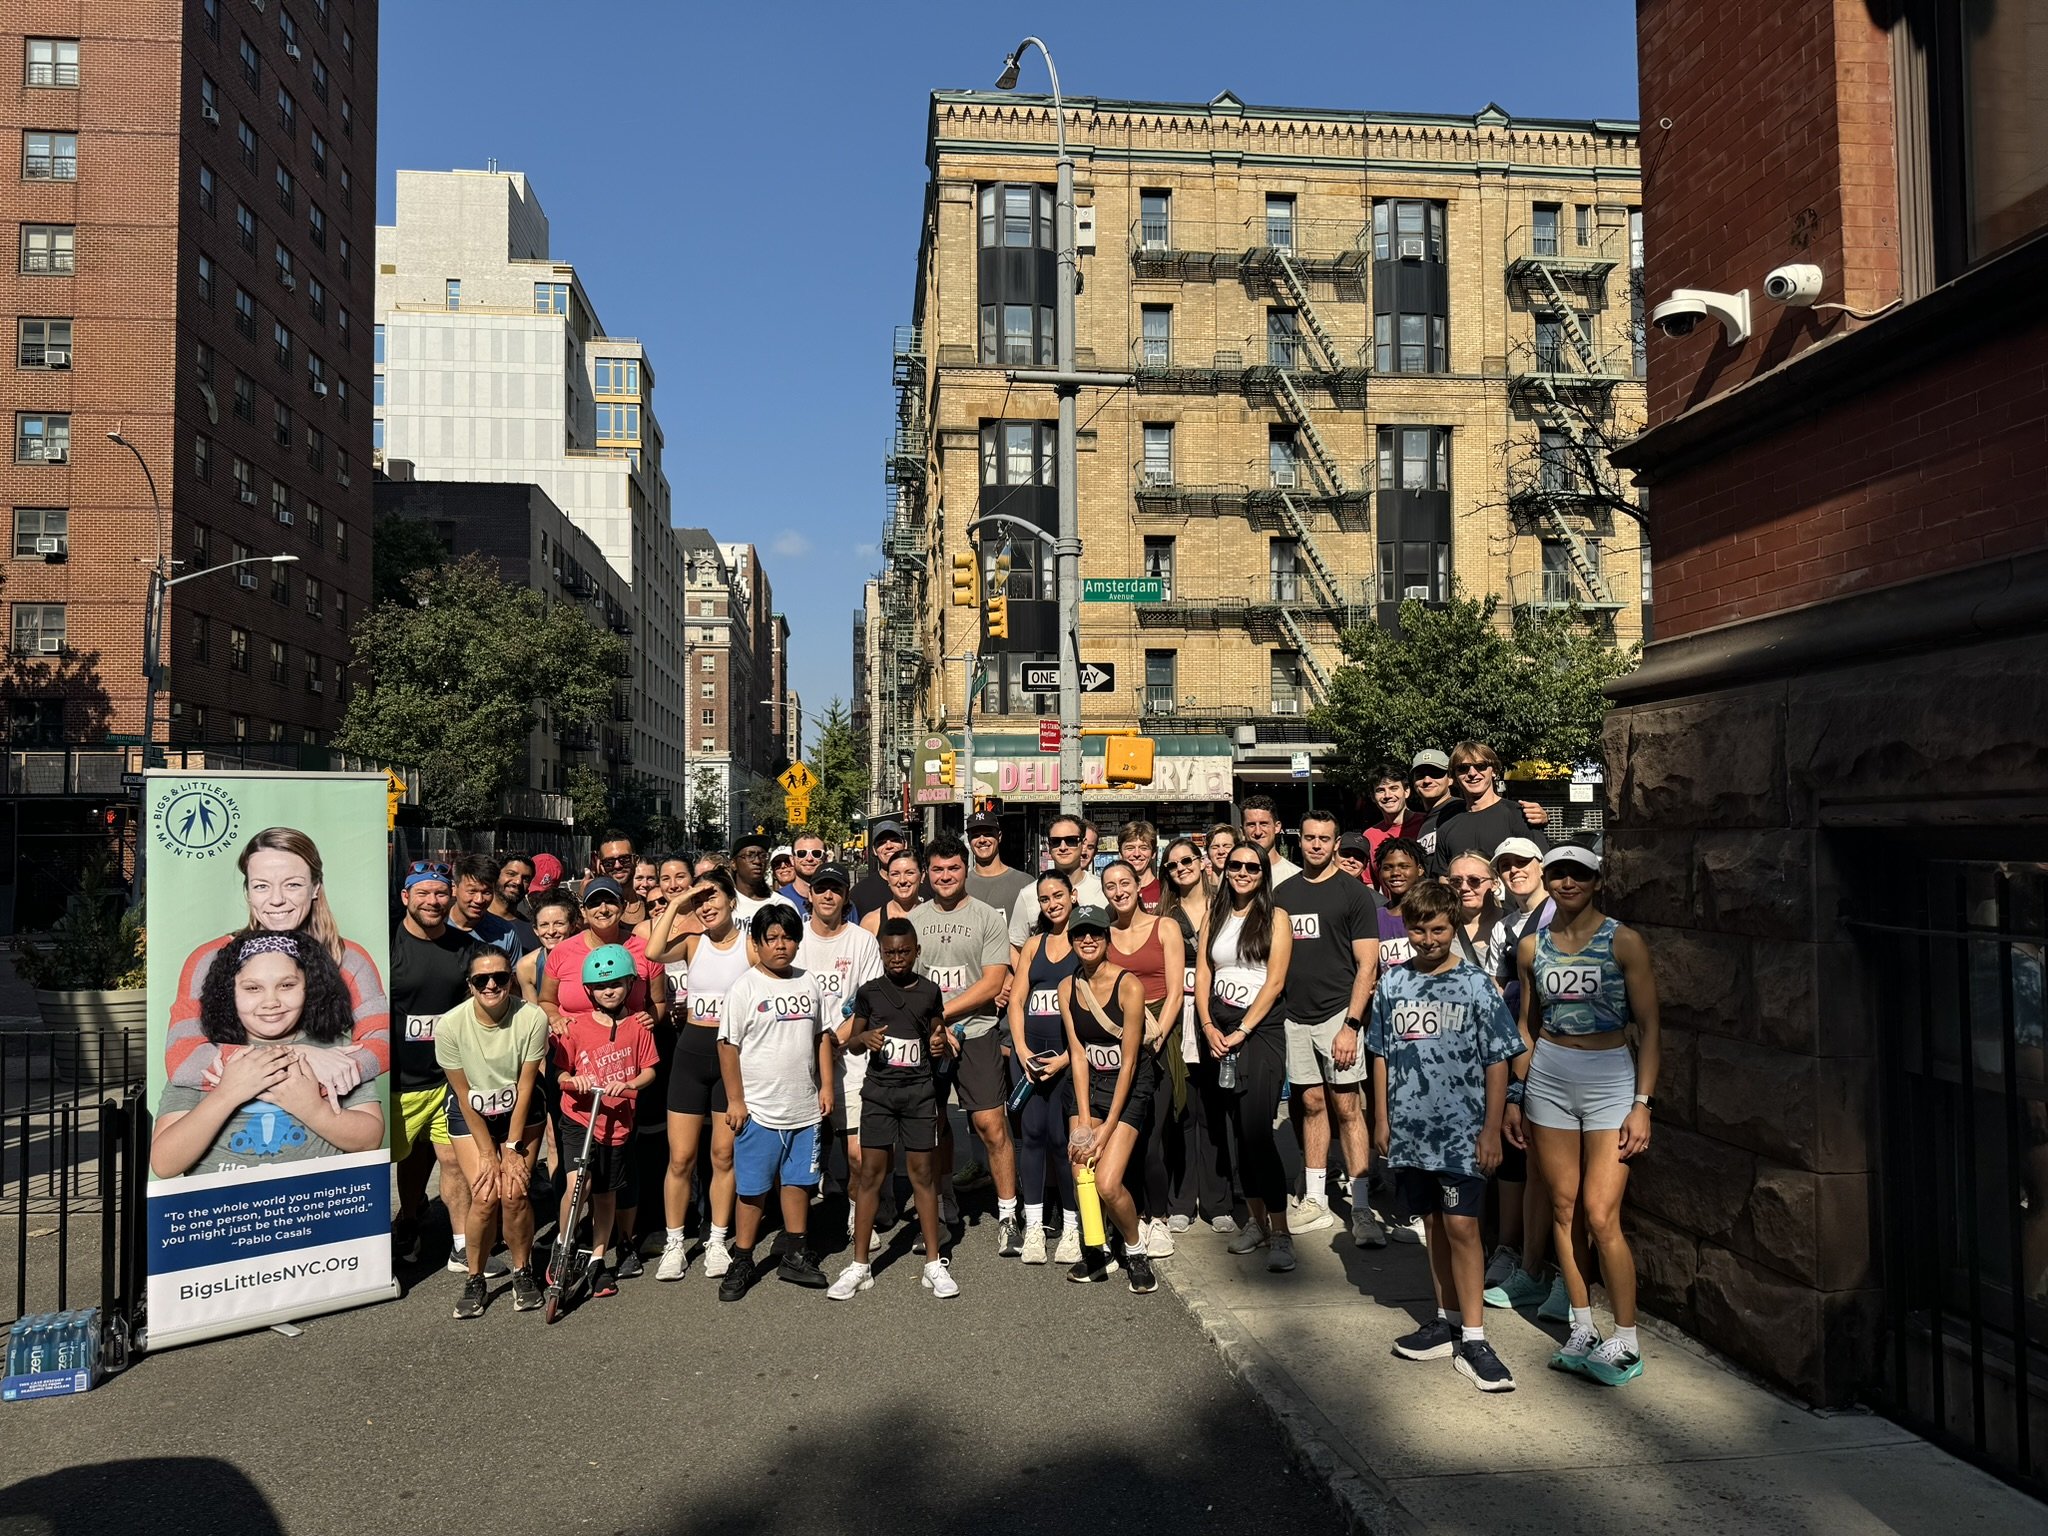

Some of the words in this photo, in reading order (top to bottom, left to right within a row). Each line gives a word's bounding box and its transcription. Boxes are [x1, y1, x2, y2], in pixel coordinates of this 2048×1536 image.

[1085, 579, 1158, 593] Amsterdam
[1031, 671, 1057, 684] ONE
[999, 761, 1061, 793] DELI
[153, 795, 171, 820] BIGS
[170, 788, 179, 796] &
[157, 832, 238, 860] MENTORING
[922, 923, 972, 938] COLGATE
[1290, 917, 1316, 935] 40
[1380, 941, 1412, 962] 041
[668, 973, 688, 993] 00
[816, 974, 839, 992] 38
[931, 969, 962, 988] 011
[1546, 970, 1598, 994] 025
[1216, 979, 1249, 1004] 002
[695, 998, 723, 1018] 04
[775, 995, 812, 1015] 039
[409, 1018, 435, 1038] 01
[1394, 1011, 1438, 1035] 026
[595, 1046, 632, 1068] KETCHUP
[883, 1039, 919, 1063] 010
[1087, 1047, 1120, 1067] 100
[601, 1066, 635, 1086] KETCUP
[471, 1089, 514, 1113] 019
[188, 1208, 209, 1218] the
[212, 1202, 249, 1214] whole
[252, 1194, 286, 1208] world
[289, 1192, 310, 1204] you
[313, 1186, 347, 1198] might
[349, 1182, 371, 1194] just
[171, 1224, 186, 1233] be
[190, 1219, 213, 1229] one
[216, 1212, 261, 1227] person,
[264, 1207, 285, 1217] but
[288, 1205, 300, 1214] to
[303, 1201, 325, 1211] one
[327, 1195, 365, 1208] person
[162, 1236, 185, 1248] you
[189, 1228, 226, 1241] might
[228, 1223, 252, 1236] just
[255, 1221, 270, 1230] be
[273, 1218, 293, 1227] the
[296, 1210, 331, 1223] whole
[275, 1227, 312, 1240] Casals
[179, 1254, 360, 1300] BigsLittlesNYC.Org
